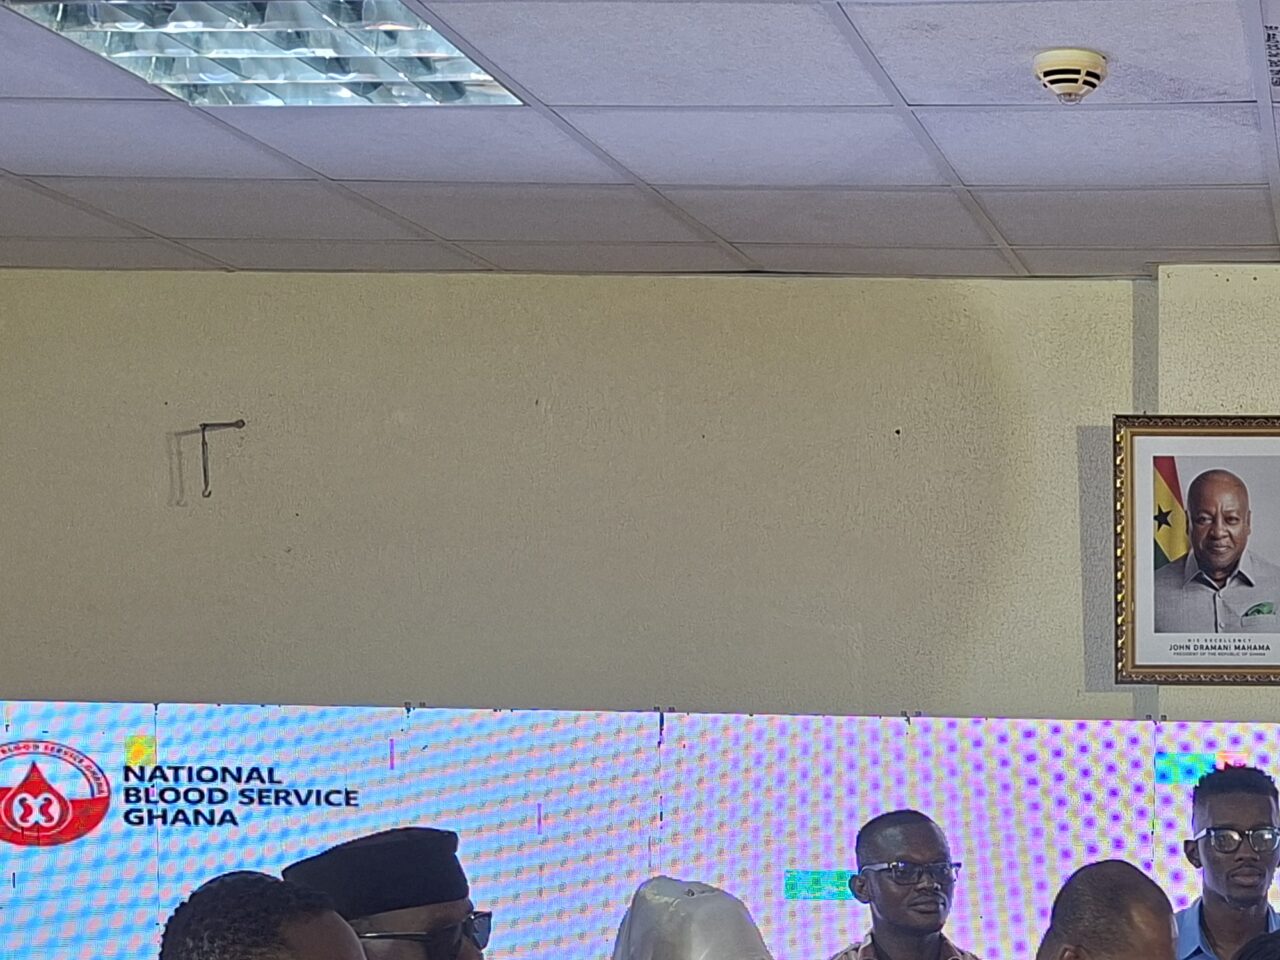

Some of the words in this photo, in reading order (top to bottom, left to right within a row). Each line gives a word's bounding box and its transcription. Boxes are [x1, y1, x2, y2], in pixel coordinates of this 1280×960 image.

[123, 766, 282, 784] NATIONAL
[124, 786, 228, 805] BLOOD
[238, 788, 359, 807] SERVICE
[123, 808, 239, 826] GHANA
